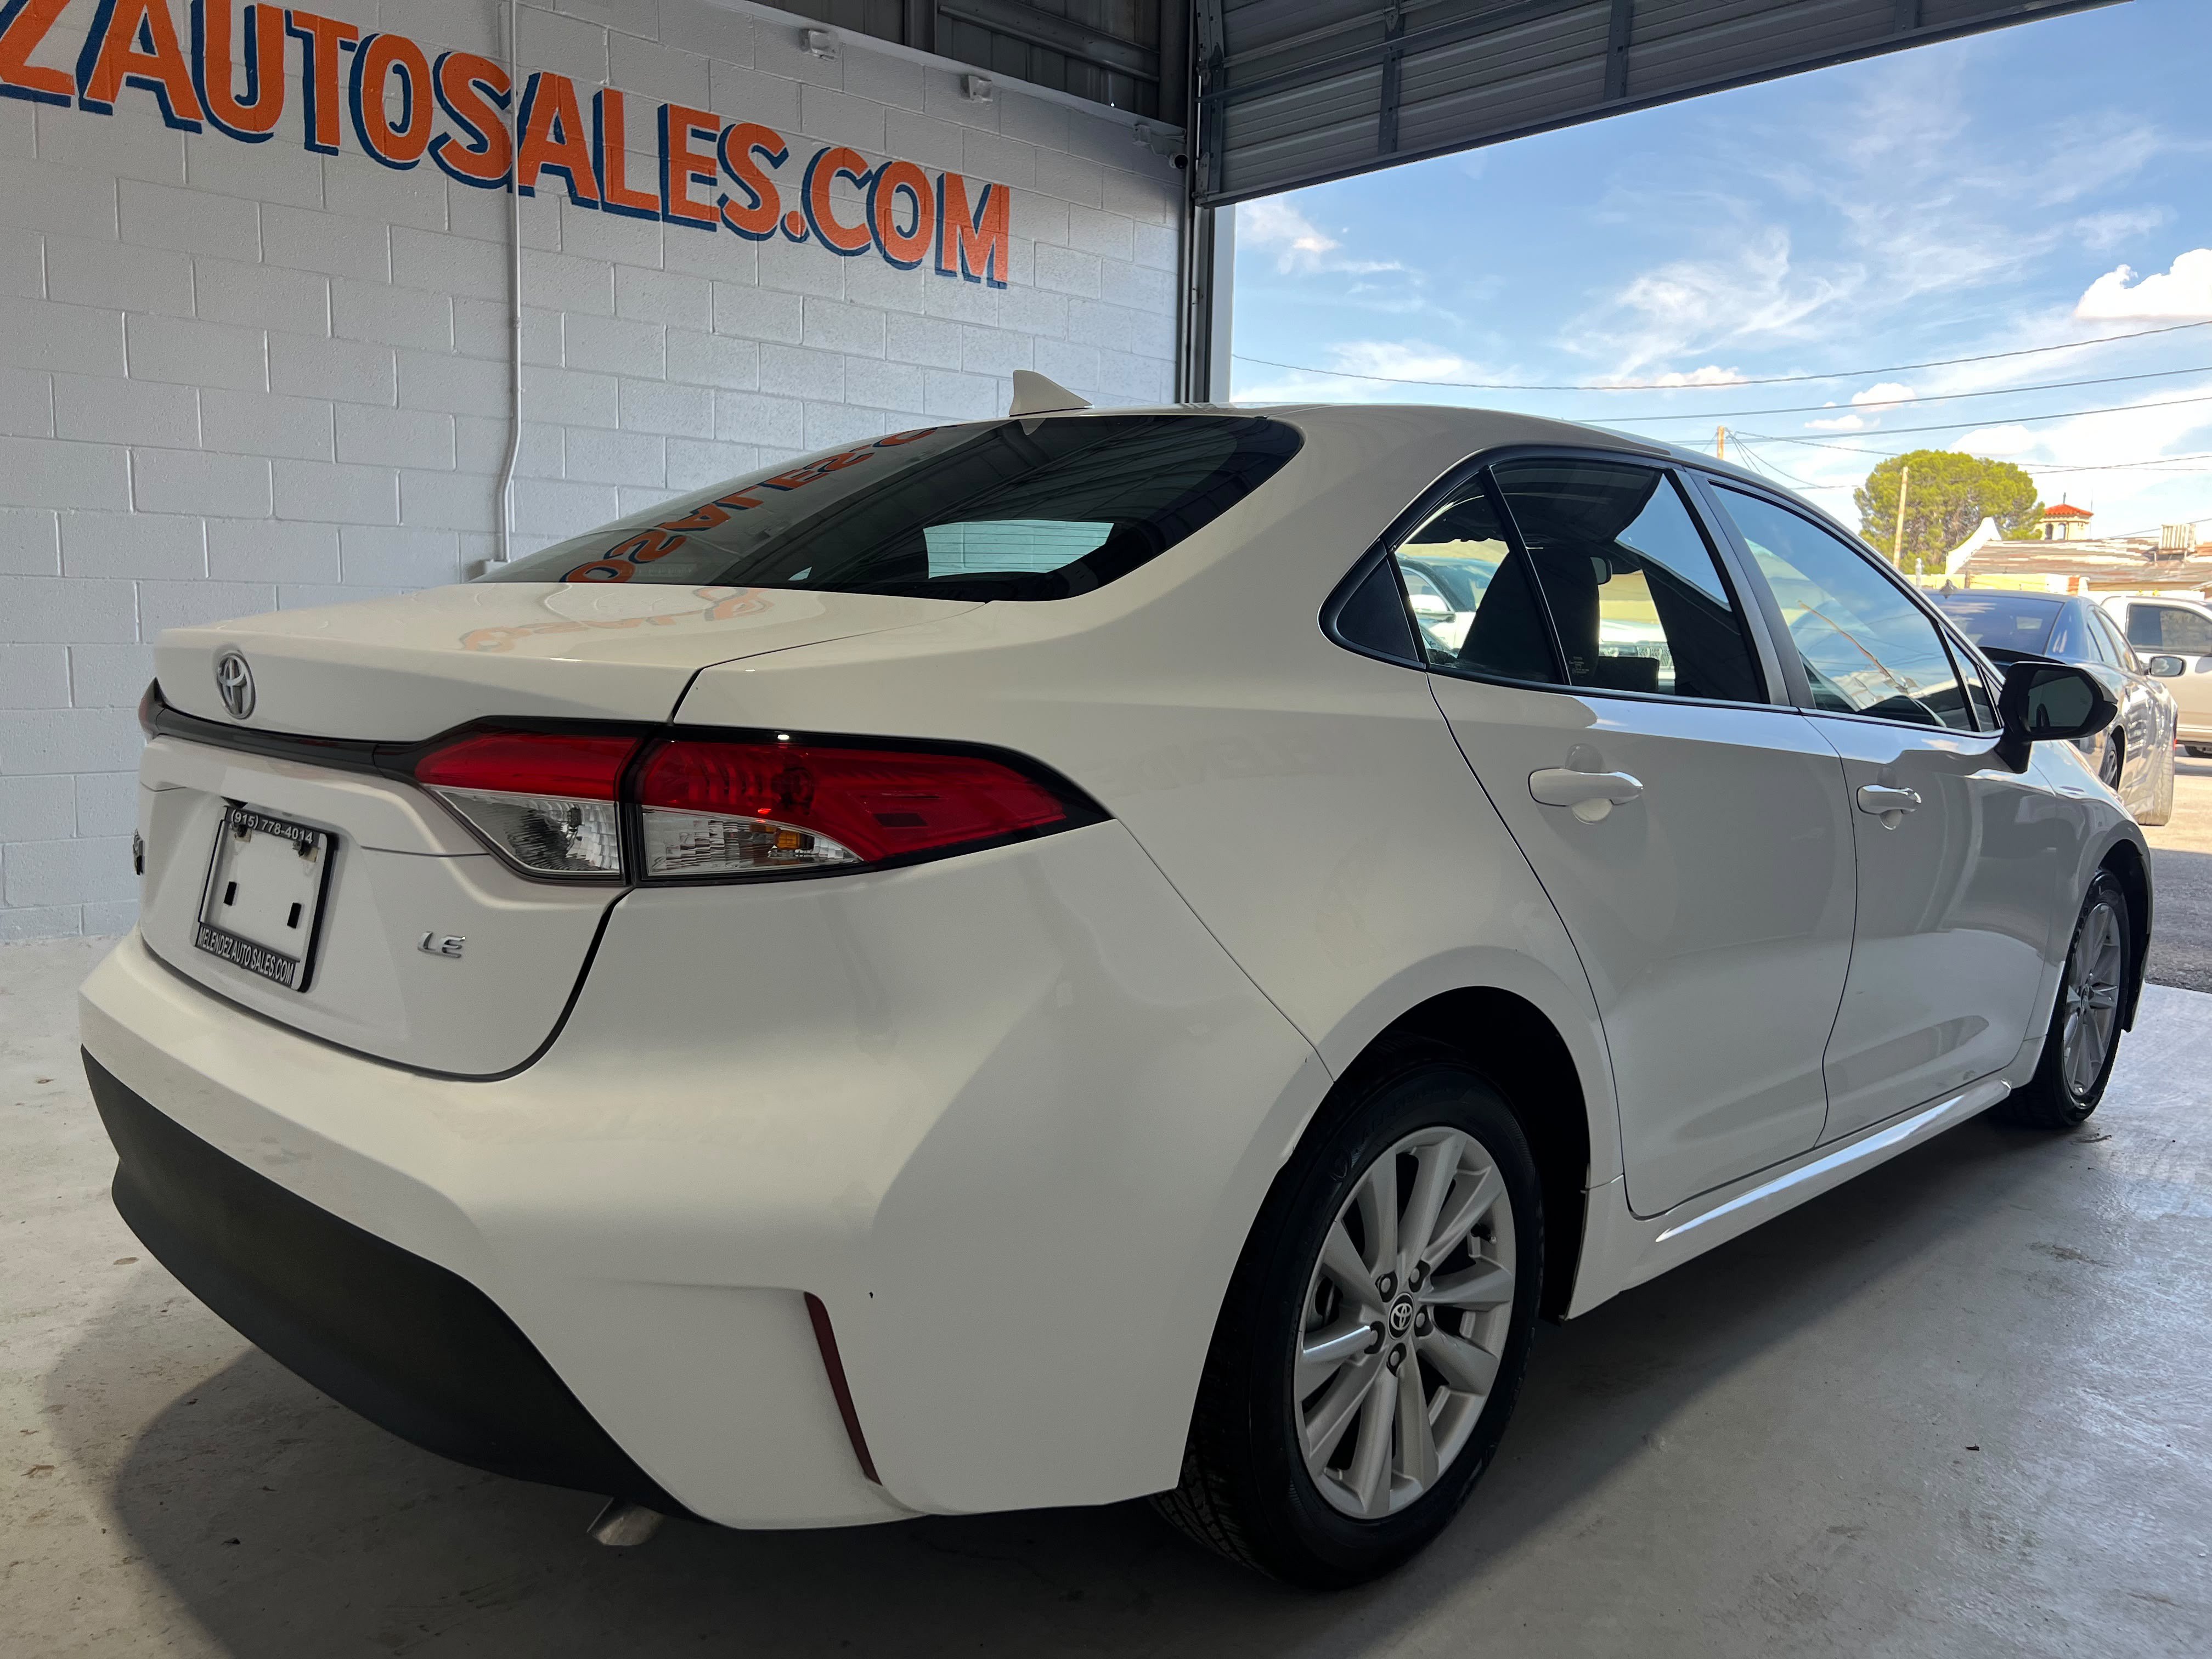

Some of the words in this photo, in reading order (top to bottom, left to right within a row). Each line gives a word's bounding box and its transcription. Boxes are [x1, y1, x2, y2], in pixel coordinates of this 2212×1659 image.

[231, 809, 259, 829] (915)
[262, 819, 313, 844] 778-4014
[198, 926, 233, 958] MELENDEZ
[231, 940, 252, 967] AUTO
[250, 948, 294, 985] SALES.COM
[417, 931, 466, 959] LE
